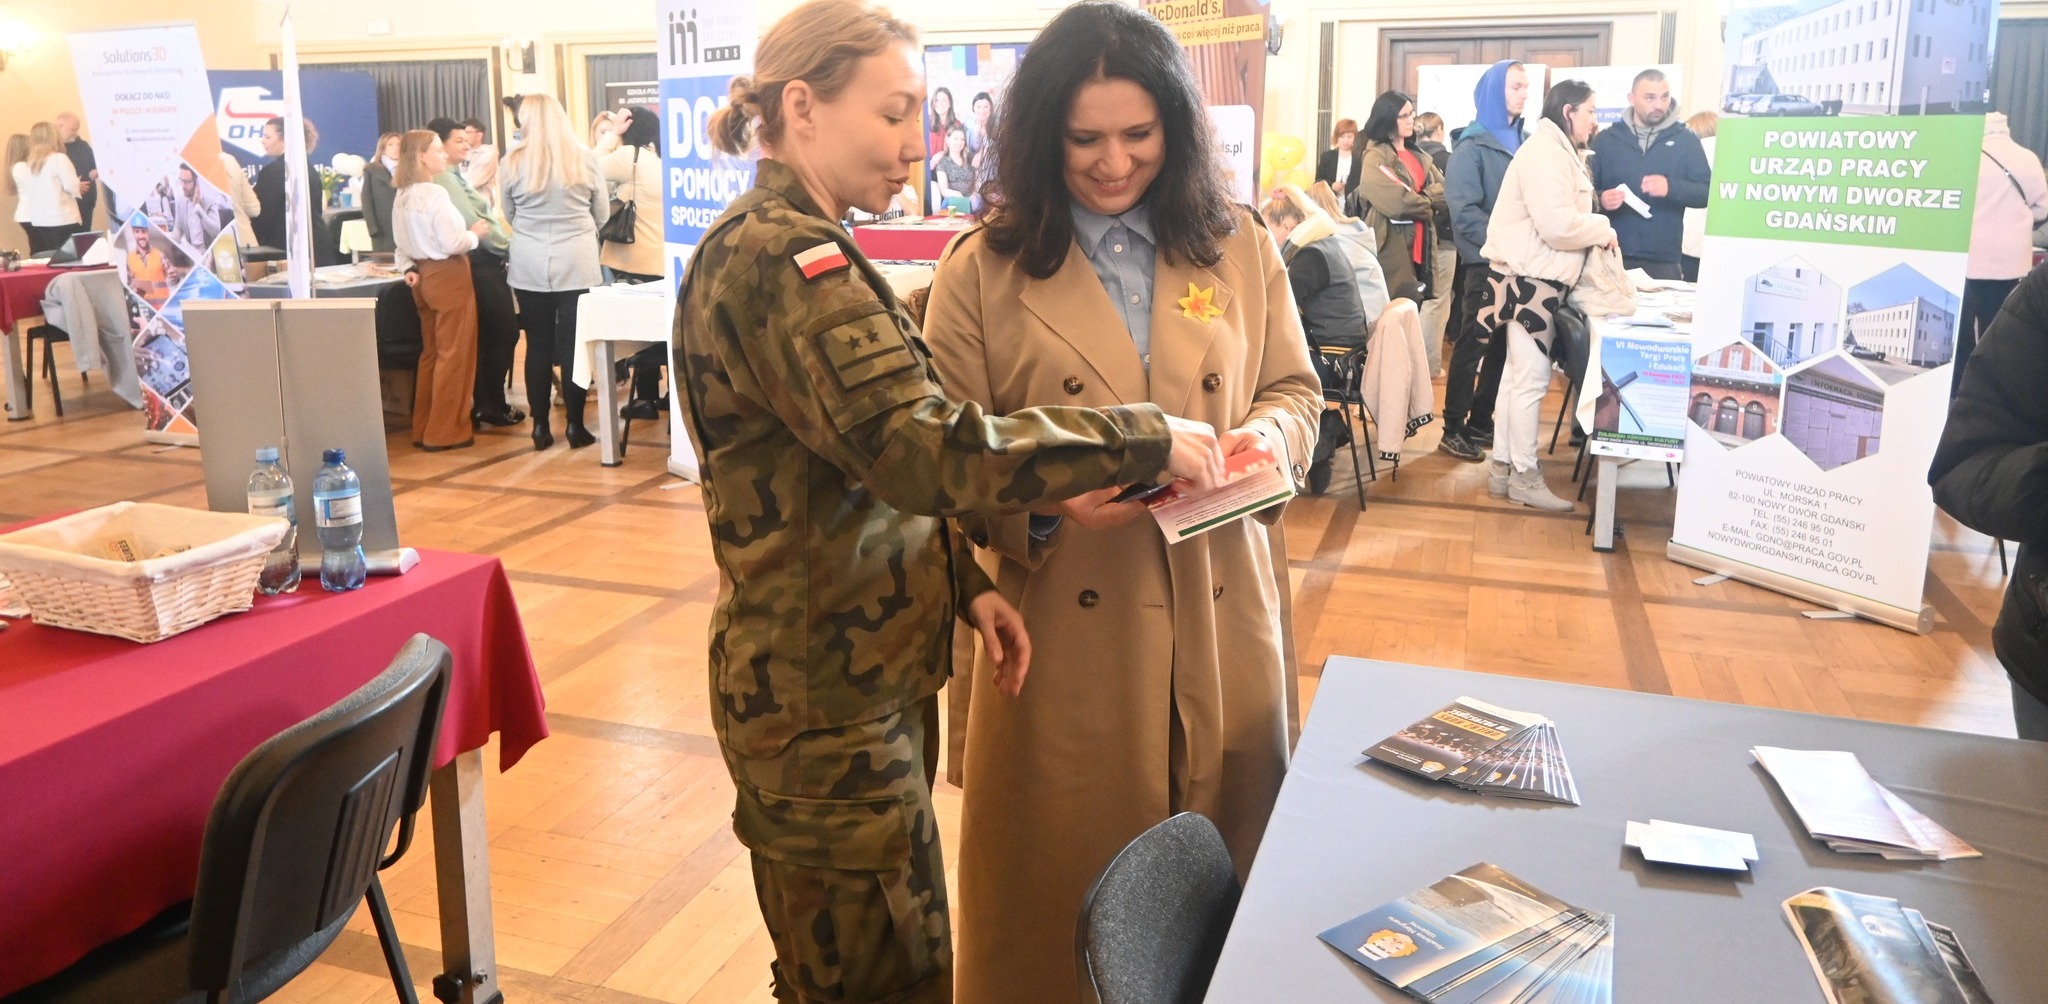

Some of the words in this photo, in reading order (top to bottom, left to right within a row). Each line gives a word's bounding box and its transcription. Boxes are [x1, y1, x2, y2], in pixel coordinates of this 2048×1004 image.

[1196, 24, 1220, 40] więcej
[1222, 23, 1234, 34] niż
[102, 46, 166, 64] Solutions30
[668, 96, 730, 160] DO
[1764, 130, 1918, 150] POWIATOWY
[1750, 156, 1832, 180] URZĄD
[1840, 158, 1928, 178] PRACY
[670, 167, 750, 202] POMOCY
[1718, 182, 1738, 200] W
[1745, 183, 1838, 204] NOWYM
[1846, 186, 1962, 210] DWORZE
[671, 206, 724, 229] SPOŁEC
[1765, 208, 1896, 235] GDAŃSKIM
[1616, 341, 1625, 349] VI
[1627, 342, 1689, 354] Nowodworskie
[1640, 352, 1661, 362] Targi
[1663, 355, 1686, 364] Pracy
[1653, 362, 1686, 372] Edukacji
[1735, 469, 1791, 489] POWIATOWY
[1793, 482, 1826, 498] URZĄD
[1828, 490, 1863, 506] PRACY
[1728, 490, 1755, 504] 82-100
[1757, 498, 1786, 512] NOWY
[1788, 503, 1818, 519] DWÓR
[1820, 513, 1866, 531] GDAŃSKI
[1780, 491, 1821, 508] MORSKA
[1772, 525, 1789, 538] (55)
[1791, 529, 1807, 541] 246
[1809, 534, 1821, 544] 95
[1823, 538, 1833, 547] 01
[1773, 513, 1790, 526] (55)
[1792, 518, 1808, 530] 246
[1810, 523, 1821, 533] 95
[1824, 526, 1835, 536] 00
[1756, 532, 1863, 568] GDNO@PRACA.GOV.PL
